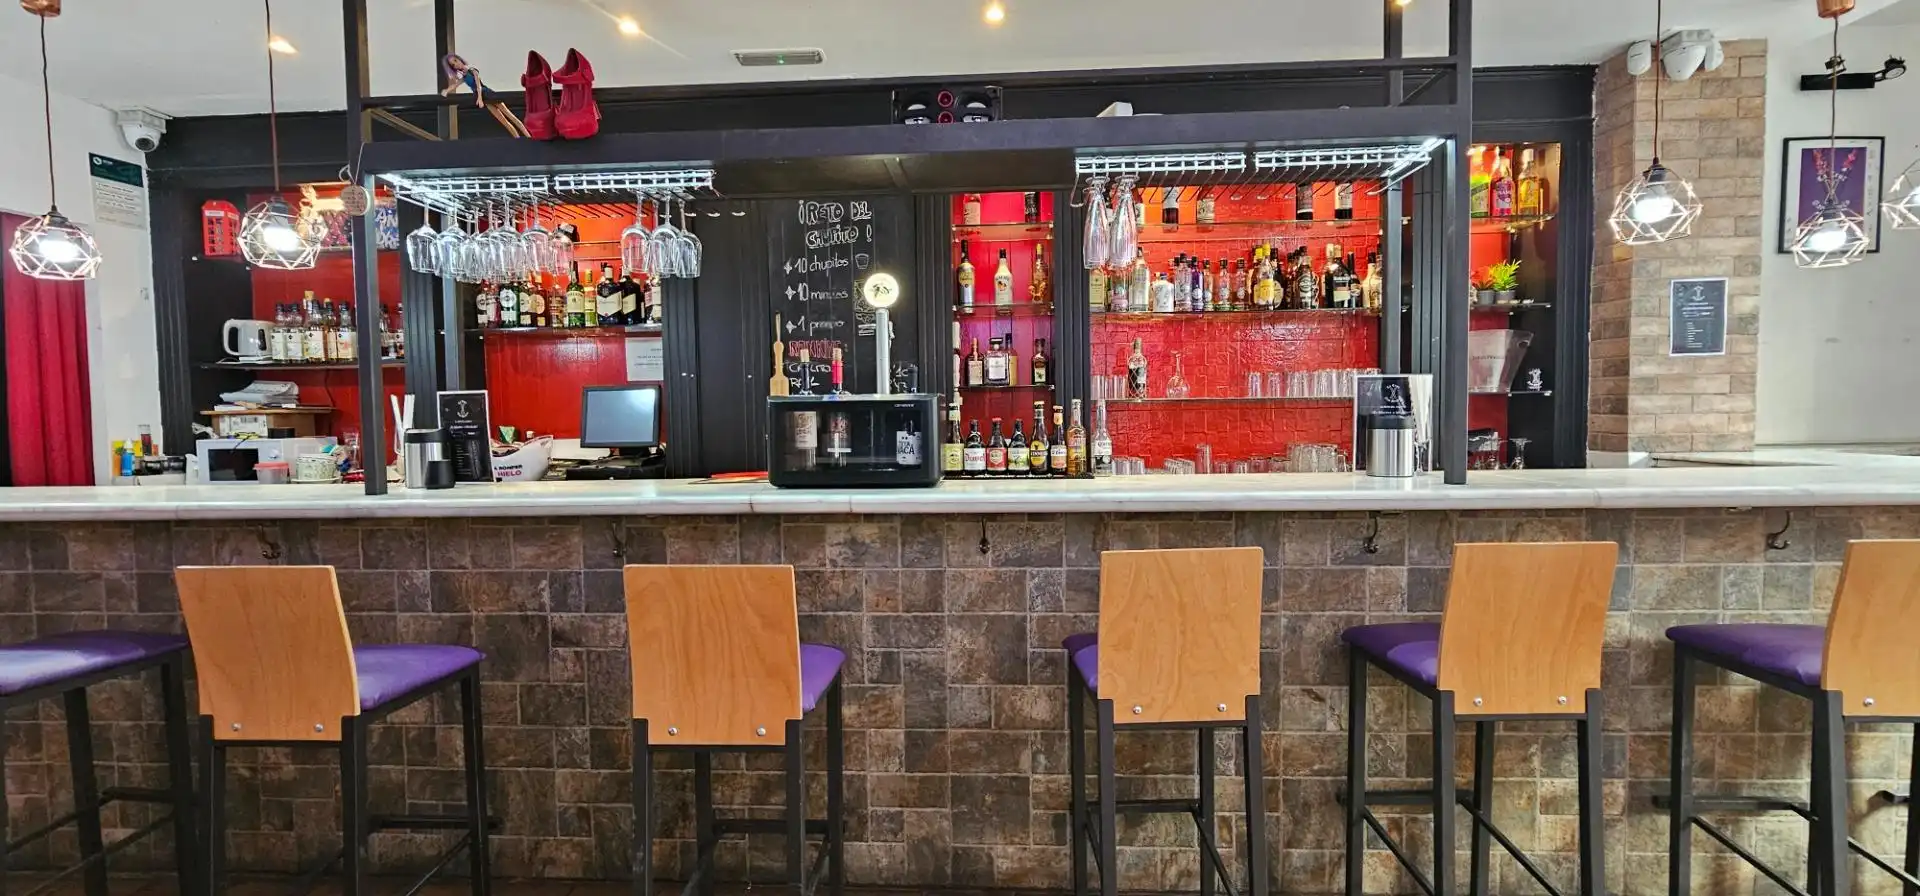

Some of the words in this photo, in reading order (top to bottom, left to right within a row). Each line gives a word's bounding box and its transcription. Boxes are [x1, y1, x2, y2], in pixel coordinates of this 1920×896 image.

[851, 201, 872, 221] DEL
[795, 257, 808, 274] 10
[810, 252, 849, 277] chupitos
[797, 283, 809, 301] 10
